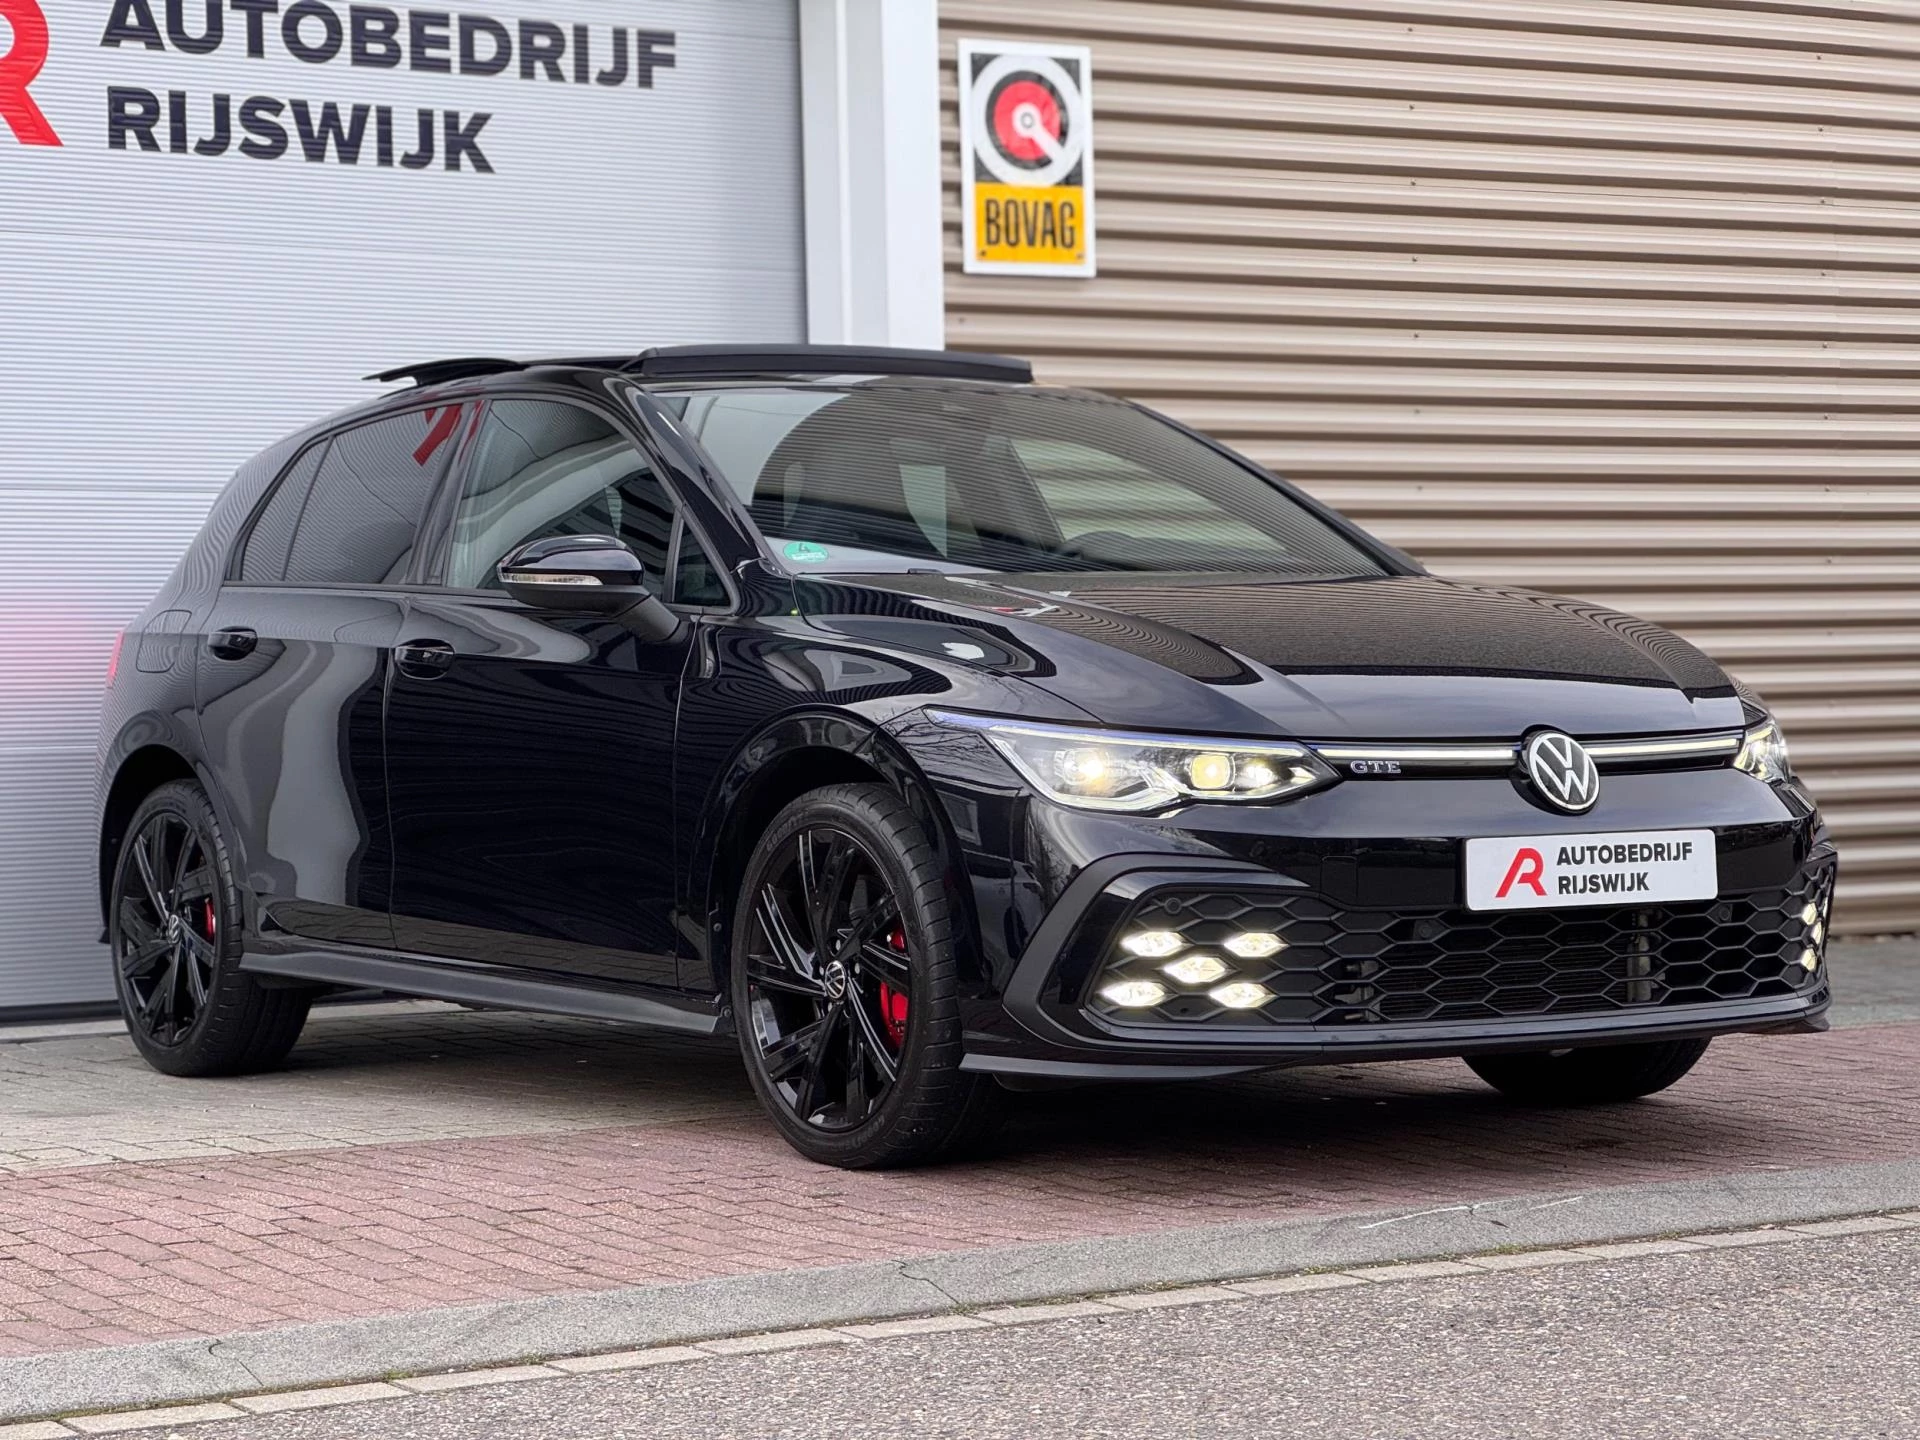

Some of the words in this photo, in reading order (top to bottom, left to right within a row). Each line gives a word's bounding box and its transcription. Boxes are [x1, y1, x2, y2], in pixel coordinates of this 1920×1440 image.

[100, 0, 676, 89] AUTOBEDRIJF
[107, 86, 495, 174] RIJSWIJK
[985, 198, 1076, 249] BOVAG
[1350, 760, 1401, 774] GTE
[1556, 841, 1693, 866] AUTOBEDRIJF
[1558, 871, 1651, 895] RIJSWIJK
